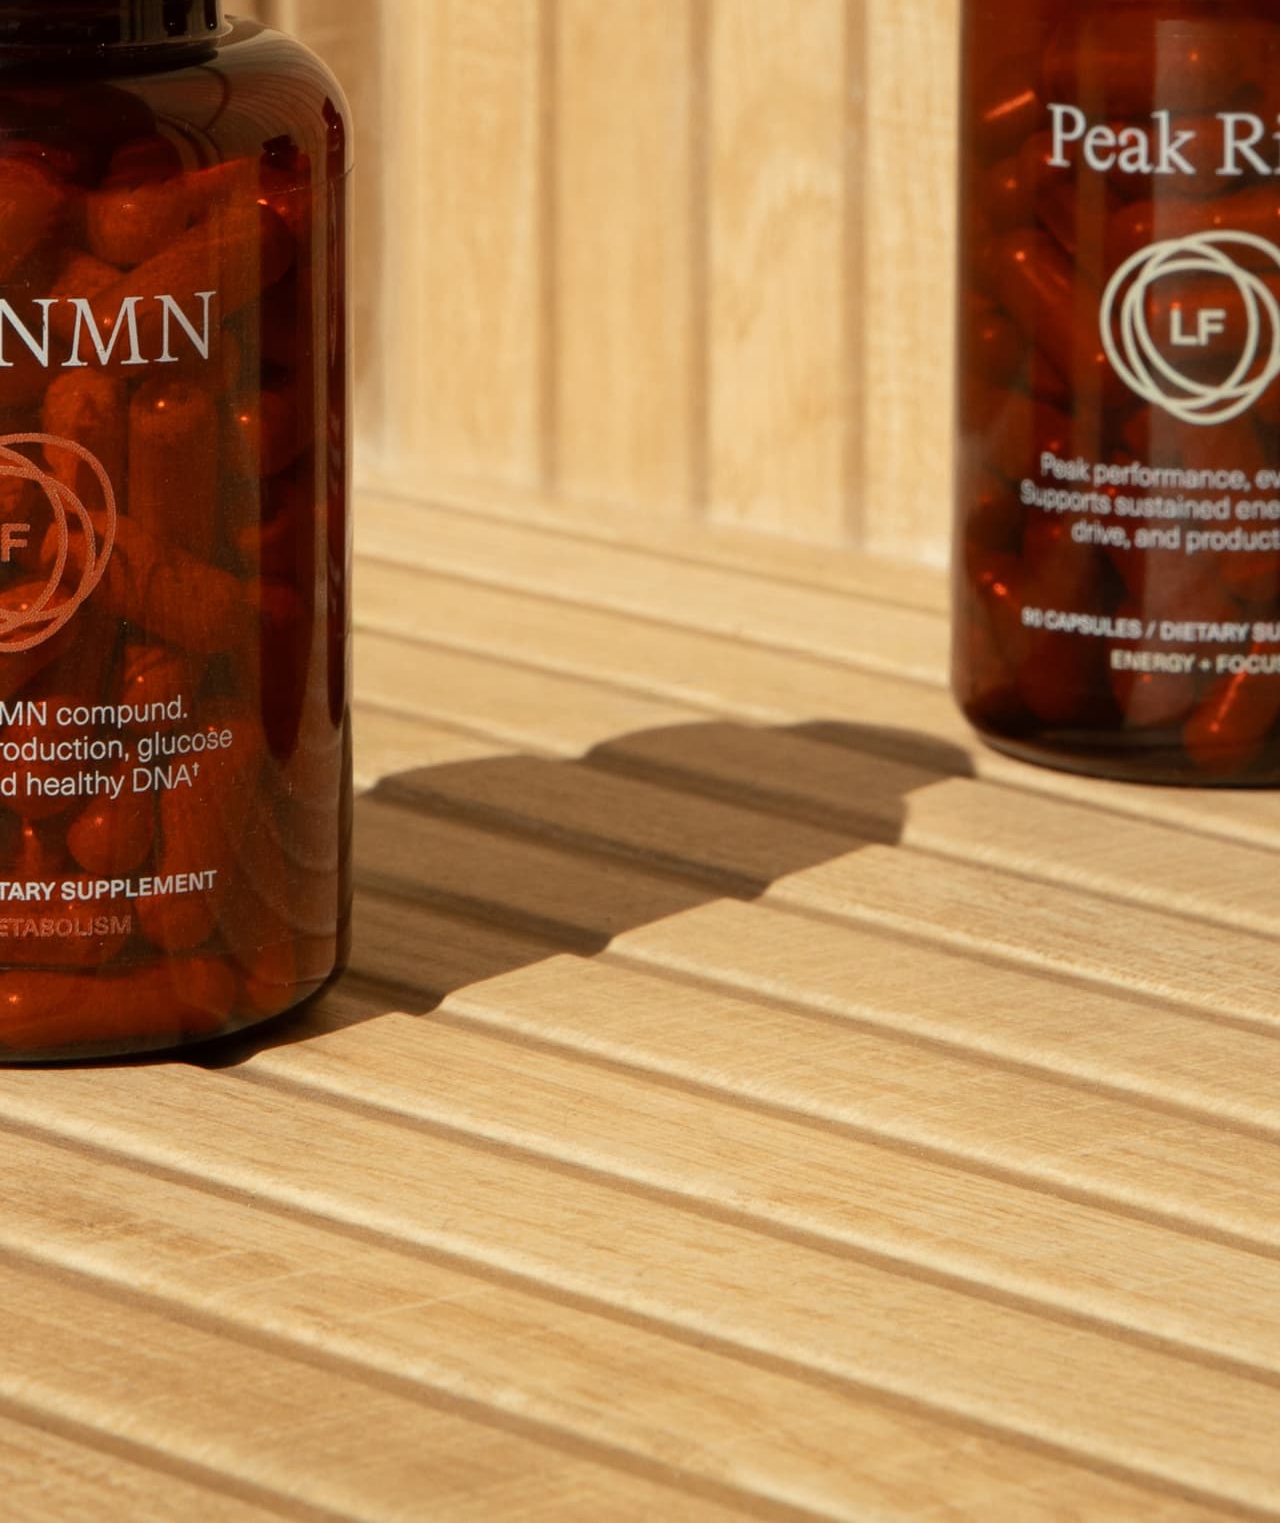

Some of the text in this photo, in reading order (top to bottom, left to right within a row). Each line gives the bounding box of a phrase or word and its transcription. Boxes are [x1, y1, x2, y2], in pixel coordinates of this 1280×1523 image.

[1047, 103, 1196, 175] Peak
[1170, 308, 1226, 346] LF
[1041, 452, 1090, 479] Peak
[1093, 462, 1252, 491] performance,
[1020, 480, 1112, 518] Supports
[1114, 492, 1231, 520] sustained
[1071, 521, 1131, 549] drive,
[1135, 524, 1180, 548] and
[1044, 610, 1142, 639] CAPSULES
[1160, 621, 1250, 642] DIETARY
[1111, 650, 1196, 672] ENERGY
[55, 695, 189, 728] compund.
[136, 725, 233, 757] glucose
[26, 770, 123, 800] healthy
[60, 869, 217, 900] SUPPLEMENT
